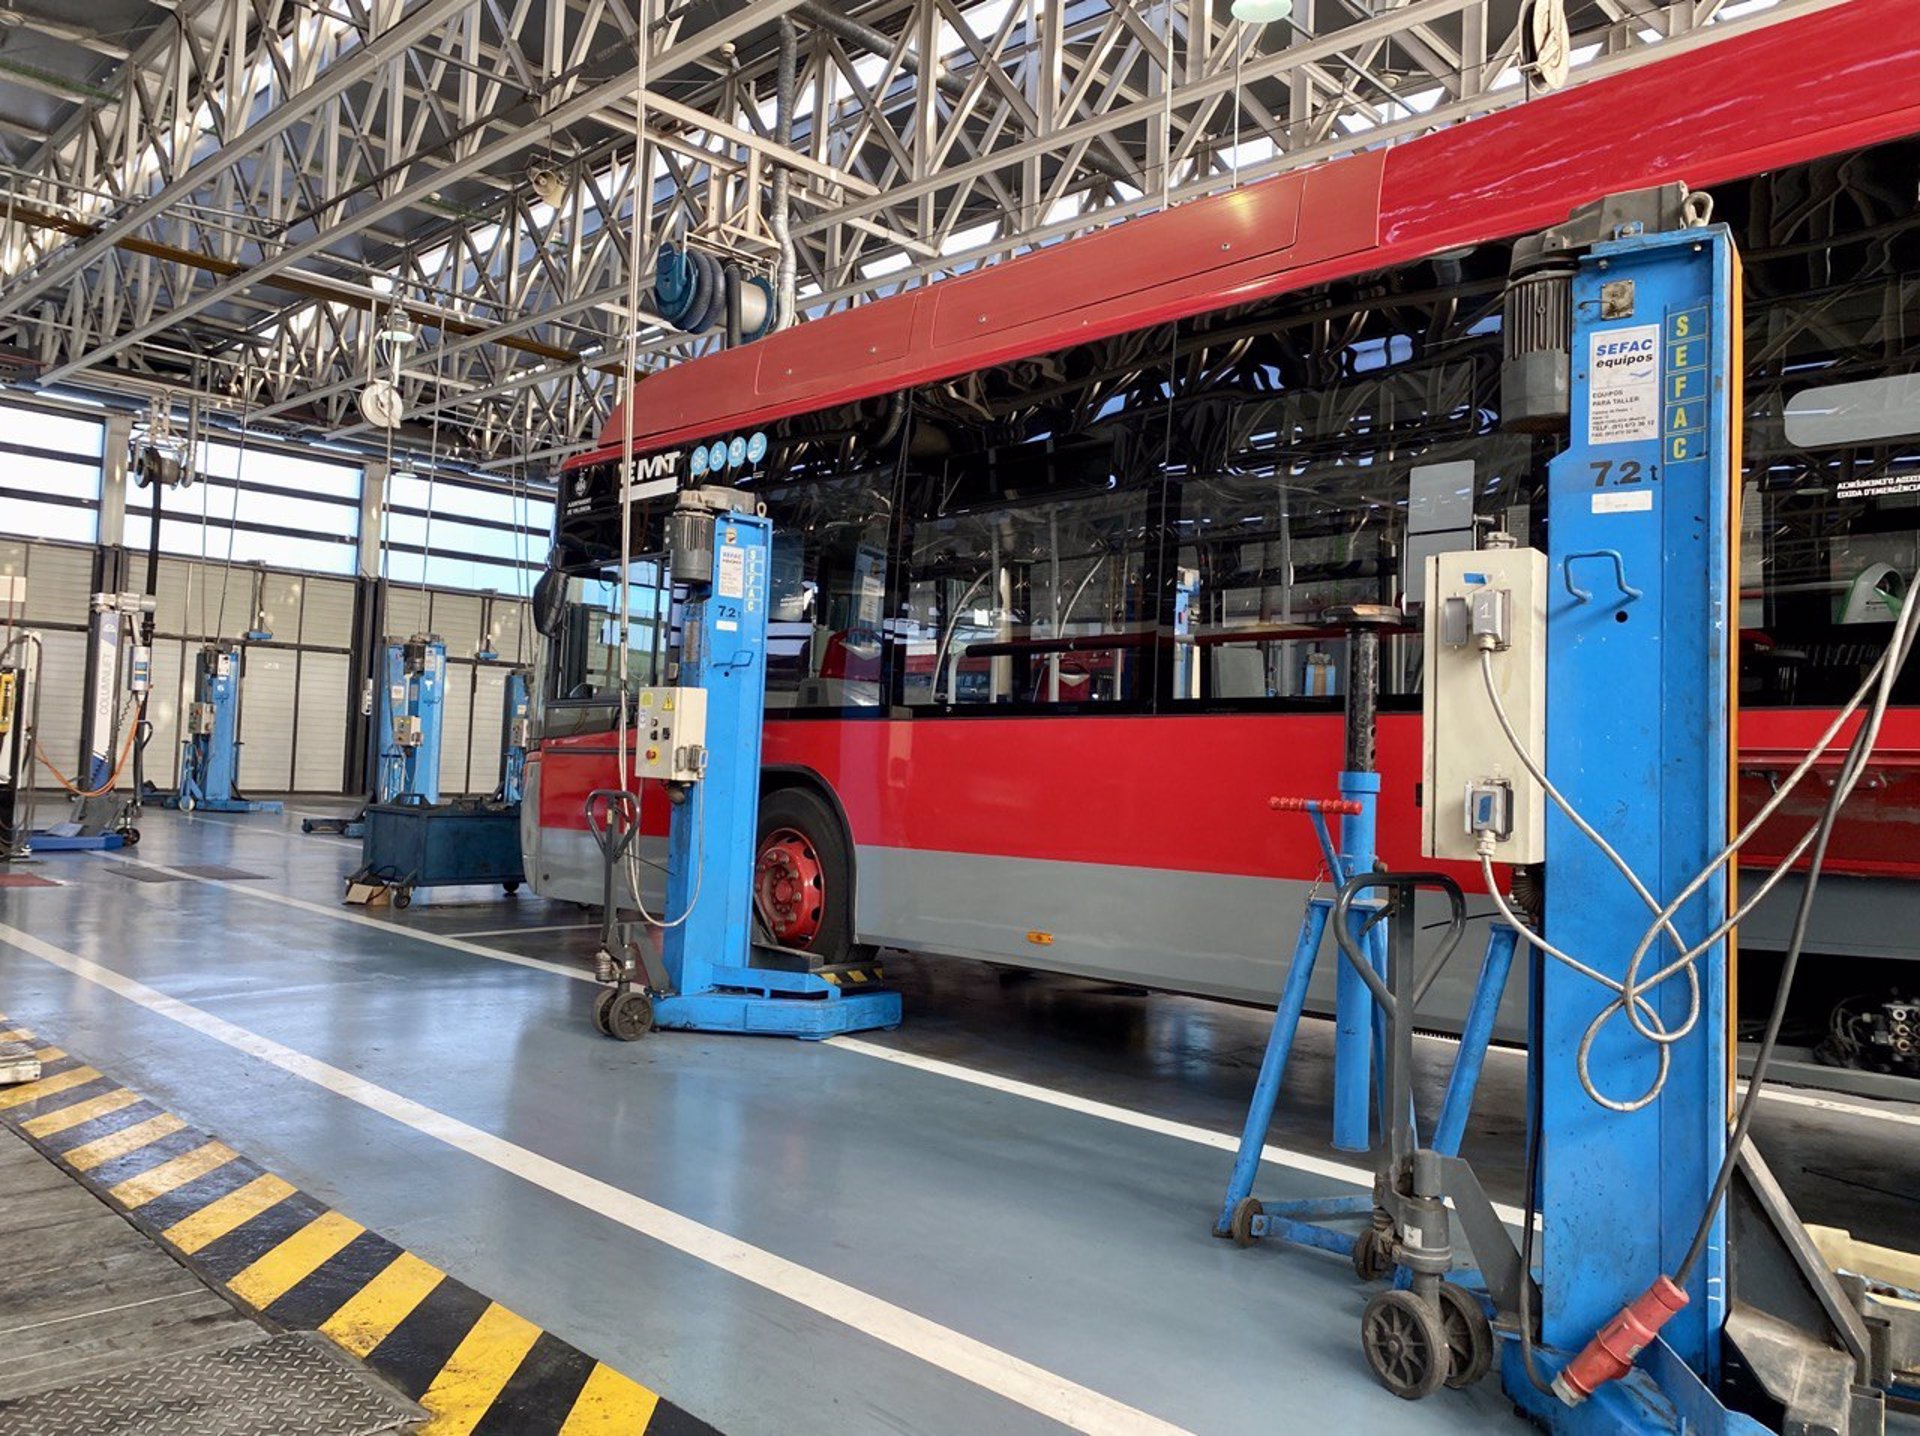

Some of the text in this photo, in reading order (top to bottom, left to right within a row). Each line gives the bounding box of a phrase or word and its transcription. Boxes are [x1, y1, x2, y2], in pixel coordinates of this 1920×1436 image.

[1596, 339, 1653, 356] SEFAC
[1596, 353, 1653, 368] equipos
[1672, 315, 1689, 459] SEFAC
[619, 451, 681, 484] EMT
[1590, 460, 1658, 487] 7.2 t
[1480, 602, 1491, 619] 1
